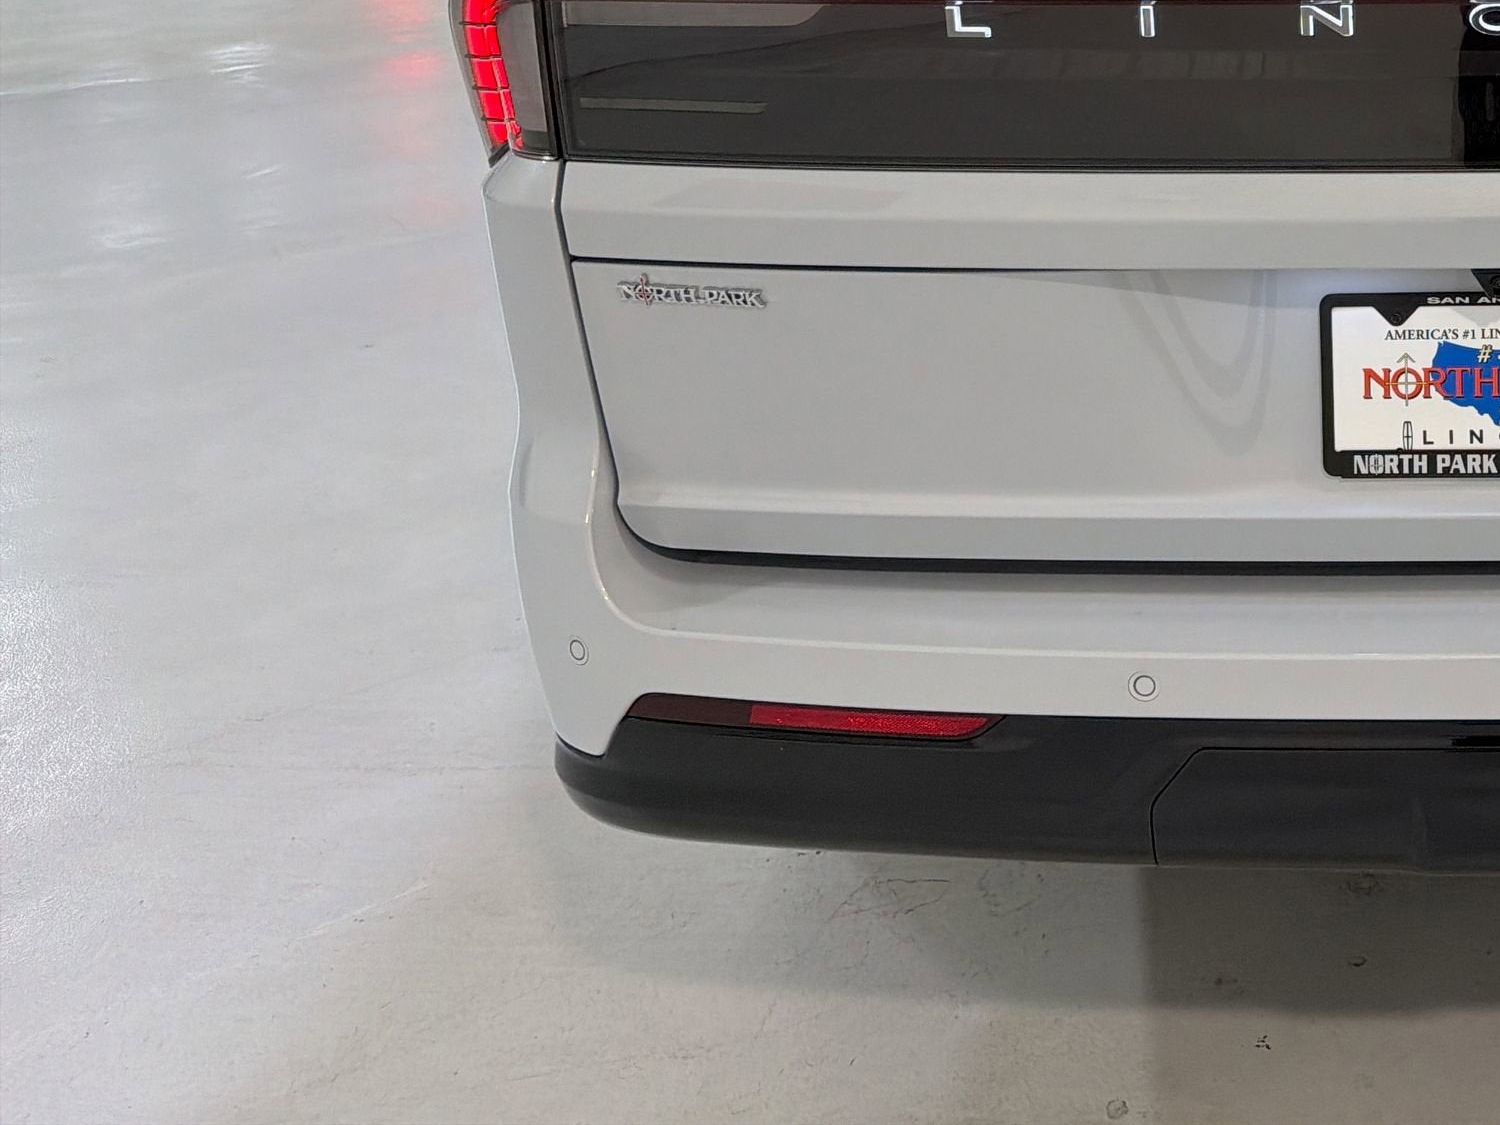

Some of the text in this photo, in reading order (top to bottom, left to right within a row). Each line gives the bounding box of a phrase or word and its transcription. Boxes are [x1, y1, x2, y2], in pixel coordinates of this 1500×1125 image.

[616, 281, 767, 308] NORTH PARK
[1427, 296, 1470, 305] SAN
[1384, 328, 1459, 341] AMERICA'S
[1462, 328, 1476, 341] #1
[1362, 365, 1500, 400] NORTH
[1353, 453, 1430, 476] NORTH
[1436, 453, 1499, 475] PARK
